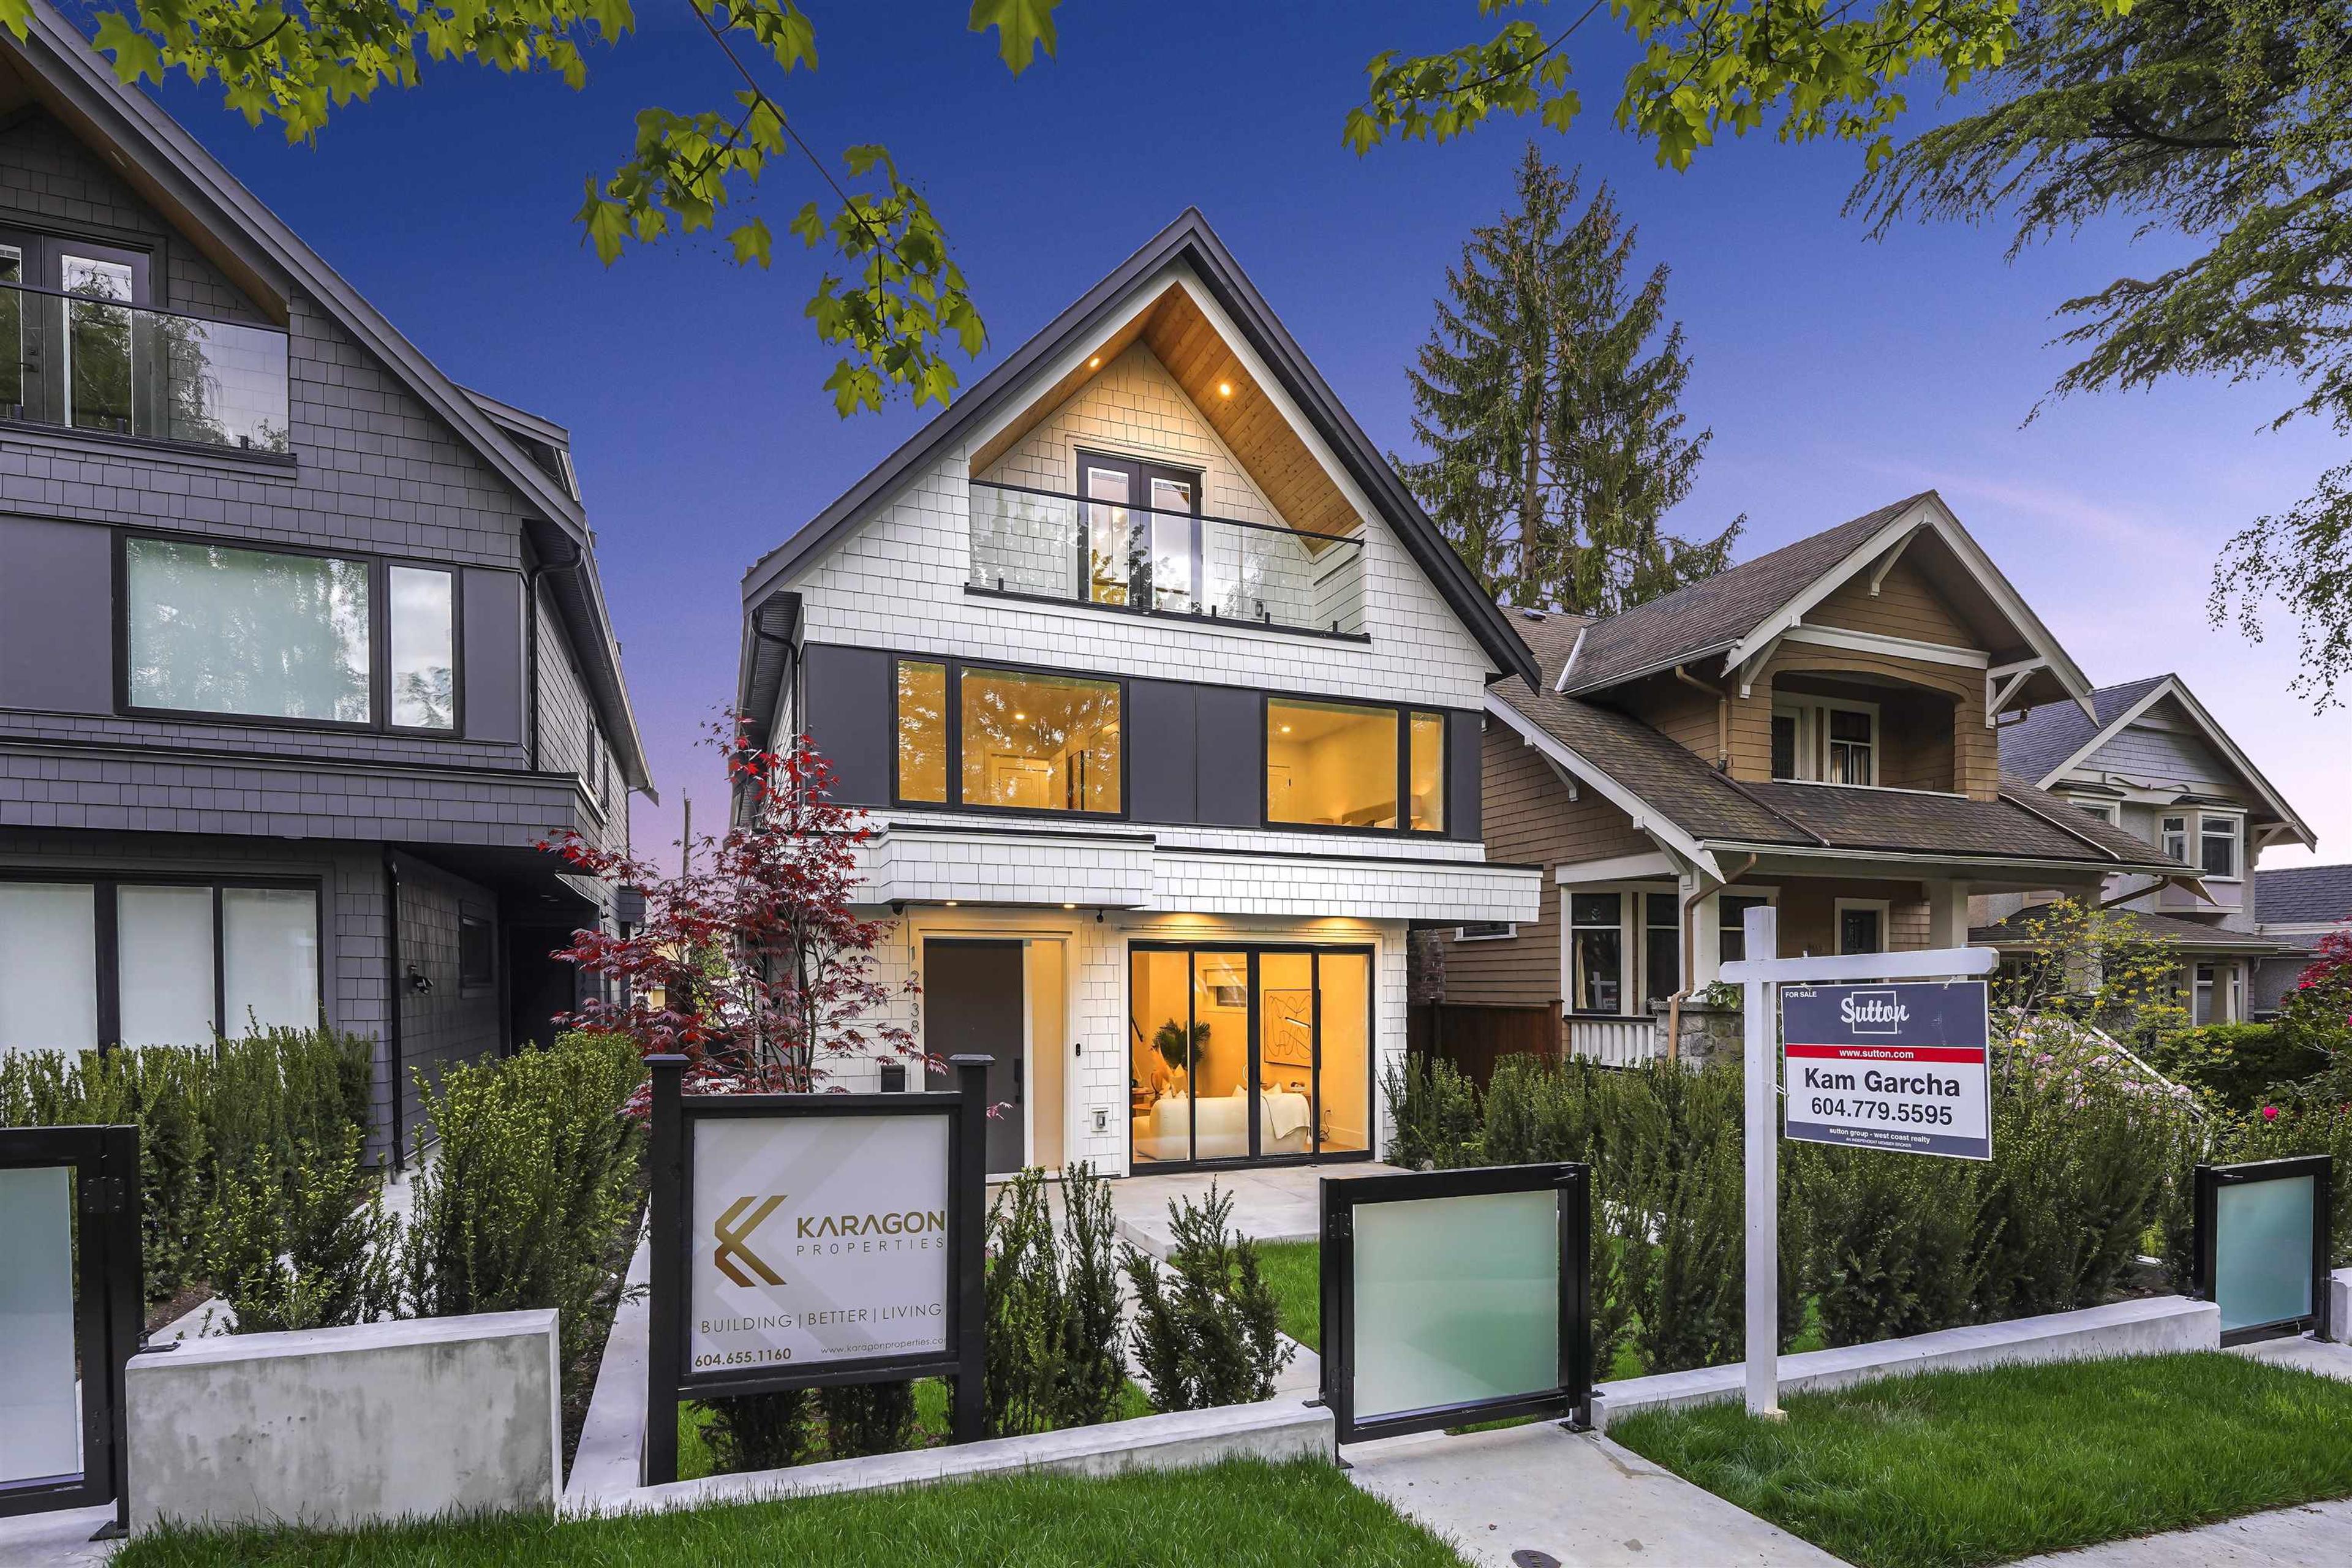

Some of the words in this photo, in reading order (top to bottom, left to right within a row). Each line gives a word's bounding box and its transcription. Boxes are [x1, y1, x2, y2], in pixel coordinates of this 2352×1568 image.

[1841, 997, 1910, 1023] Sutton
[1839, 1049, 1914, 1058] www.sutton.com
[1805, 1068, 1855, 1090] Kam
[1864, 1070, 1960, 1096] Garcha
[1812, 1097, 1953, 1126] 604.779.5595
[1910, 1135, 1931, 1144] realty
[797, 1210, 945, 1238] KARAGON
[797, 1237, 944, 1256] PROPERTIES
[702, 1315, 792, 1334] BUILDING
[809, 1309, 867, 1325] BETTER
[883, 1303, 941, 1319] LIVING
[821, 1338, 946, 1354] www.karagonproperties.co
[695, 1348, 791, 1367] 604.655.1160
